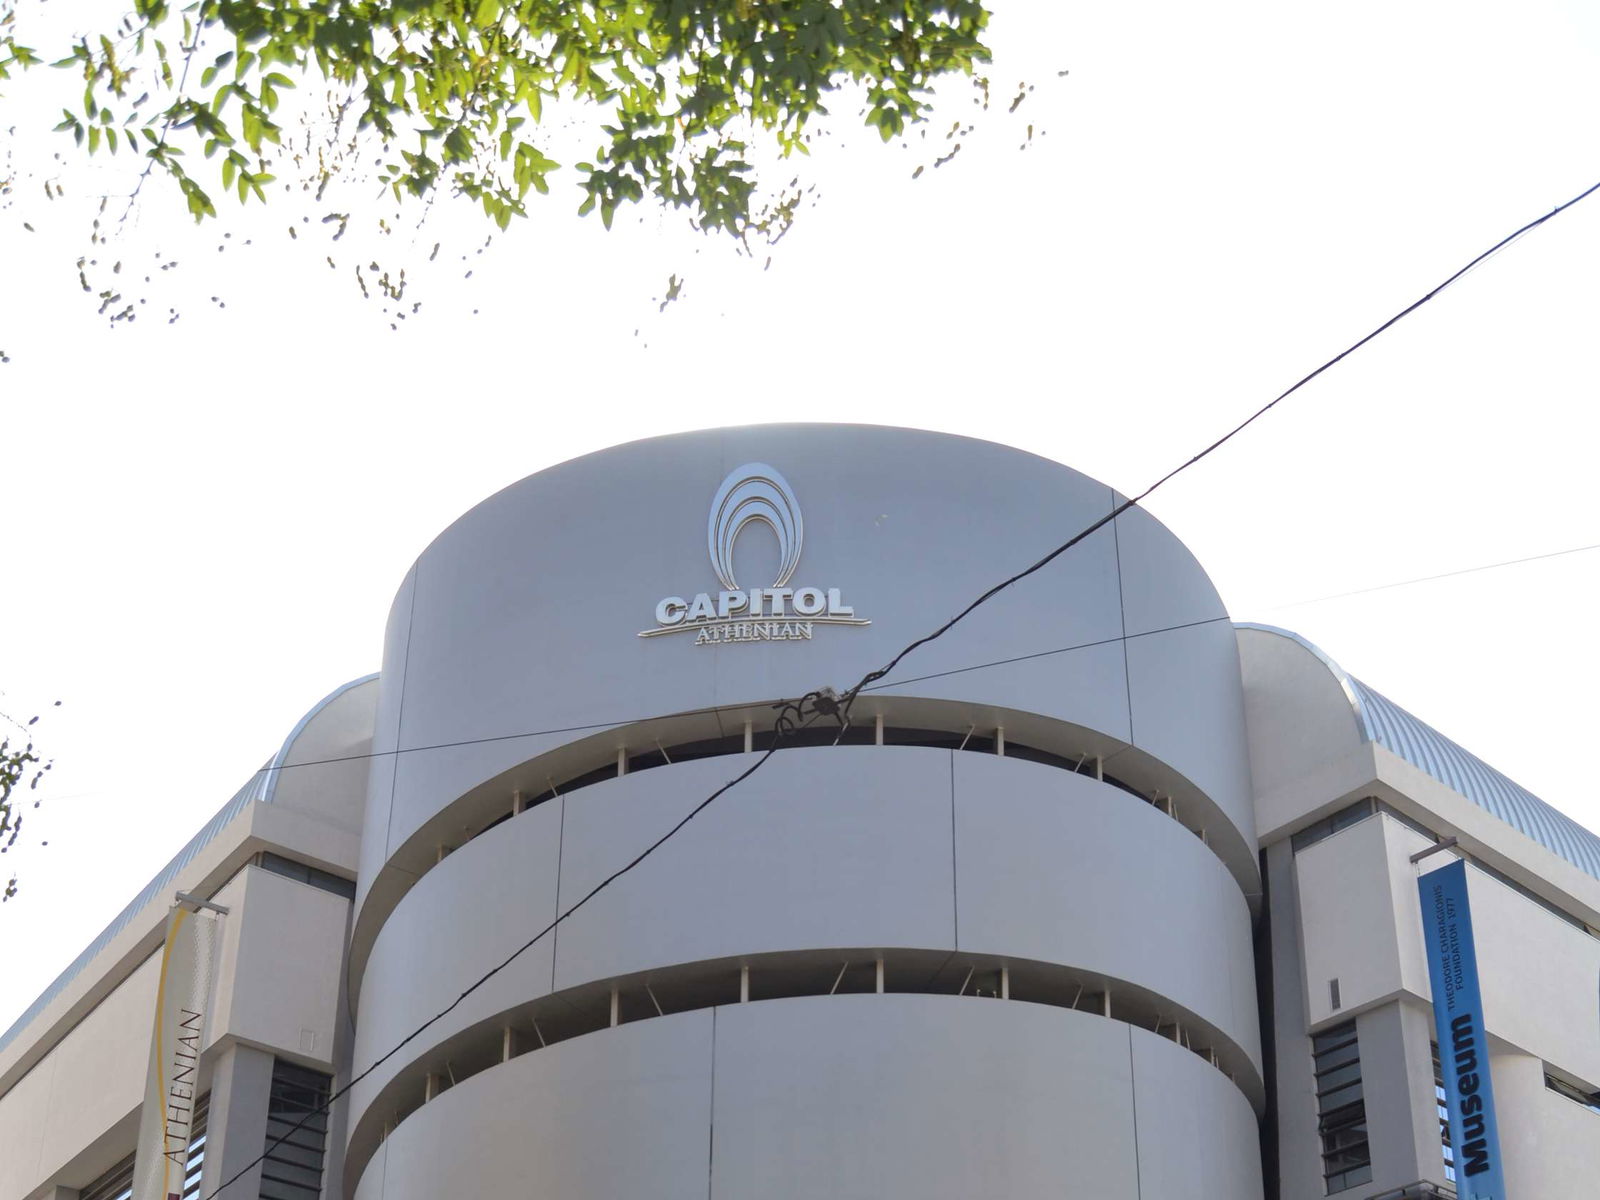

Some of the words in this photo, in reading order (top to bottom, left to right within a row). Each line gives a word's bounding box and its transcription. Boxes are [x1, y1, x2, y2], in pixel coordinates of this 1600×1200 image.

[655, 587, 855, 626] CAPITOL
[695, 622, 814, 645] ATHENIAN
[1445, 897, 1457, 920] 1977
[1442, 955, 1456, 1012] THEODORE
[1447, 923, 1464, 991] FOUNDATION
[163, 1008, 202, 1166] ATHENIAN
[1450, 1012, 1491, 1178] Museum
